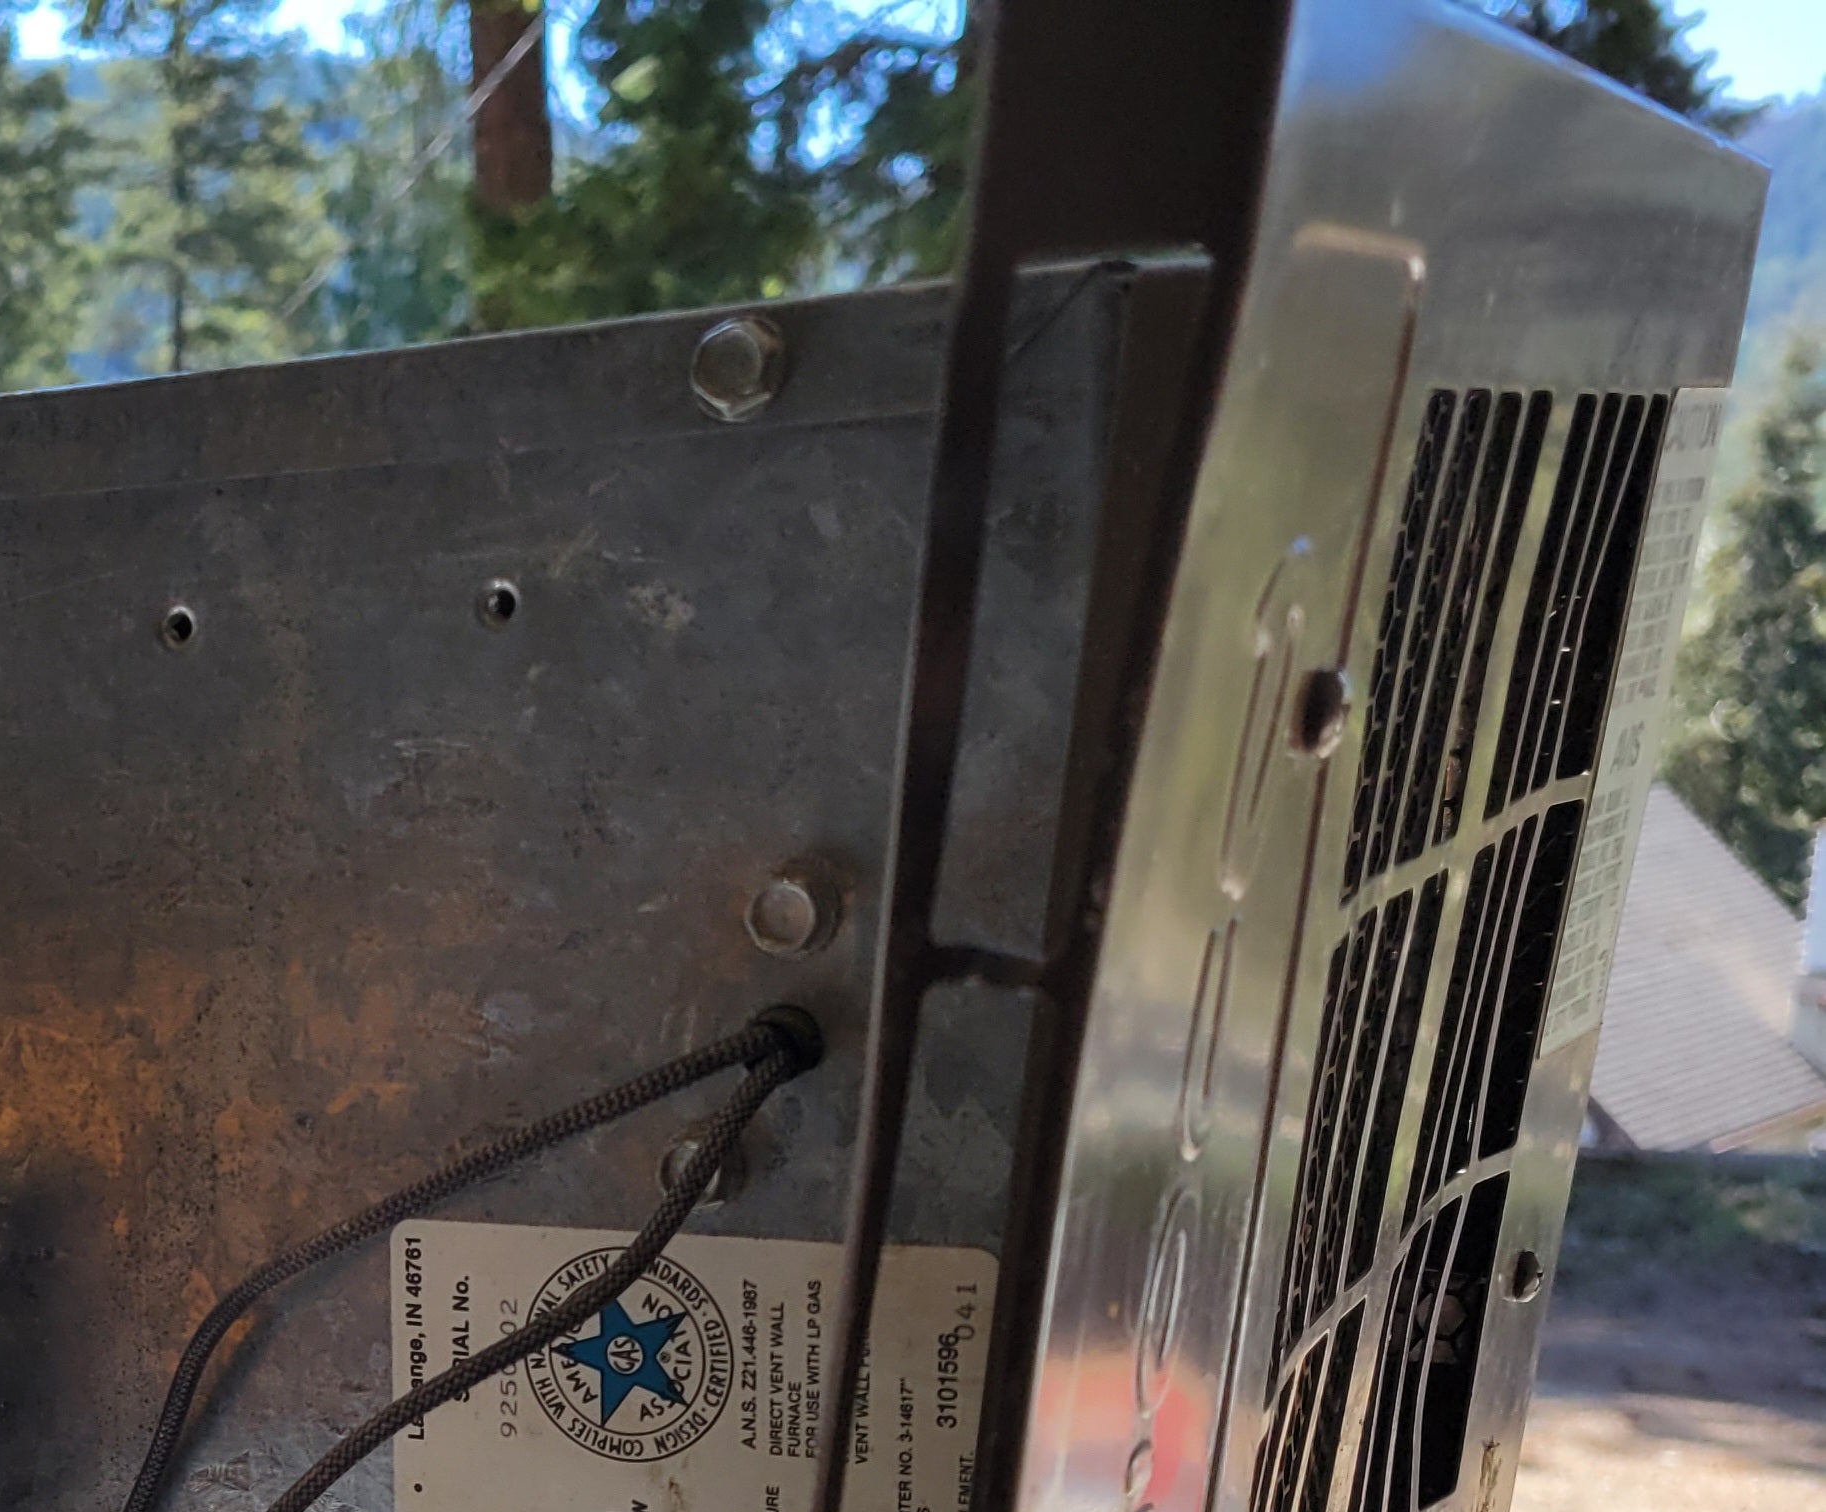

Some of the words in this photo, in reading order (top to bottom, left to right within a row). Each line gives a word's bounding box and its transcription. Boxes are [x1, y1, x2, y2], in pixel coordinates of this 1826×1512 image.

[404, 1238, 422, 1298] 46761
[557, 1253, 610, 1291] SAFETY
[452, 1276, 470, 1312] No.
[808, 1280, 822, 1314] GAS
[406, 1304, 422, 1326] IN
[770, 1302, 784, 1348] WALL
[808, 1318, 820, 1338] LP
[609, 1338, 641, 1372] GAS
[704, 1319, 727, 1408] CERTIFIED
[770, 1352, 784, 1394] VENT
[806, 1344, 820, 1384] WITH
[535, 1376, 566, 1419] WITH
[937, 1333, 959, 1428] 3101596
[742, 1396, 756, 1450] A.N.S.
[788, 1382, 802, 1458] FURNACE
[806, 1390, 820, 1420] USE
[568, 1417, 644, 1456] COMPLIES
[770, 1398, 782, 1456] DIRECT
[806, 1425, 819, 1459] FOR
[855, 1423, 868, 1464] VENT
[898, 1448, 913, 1475] NO.
